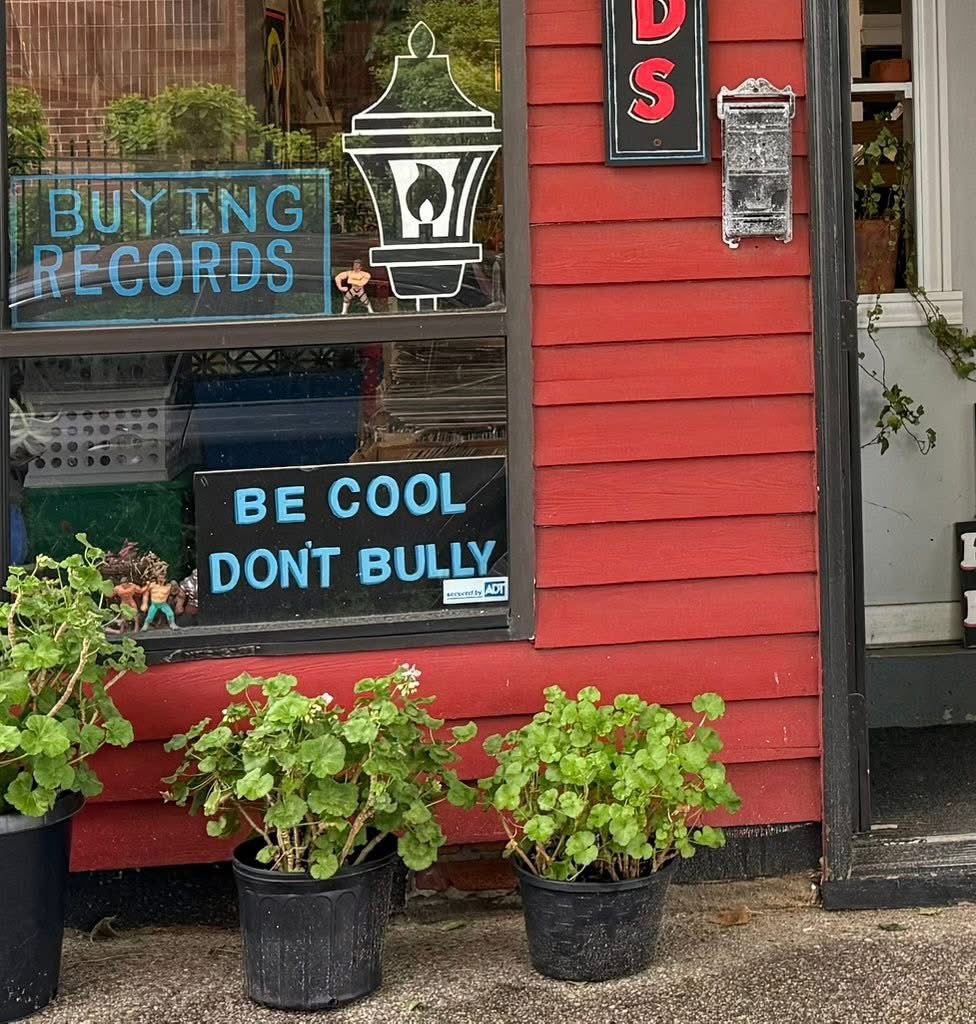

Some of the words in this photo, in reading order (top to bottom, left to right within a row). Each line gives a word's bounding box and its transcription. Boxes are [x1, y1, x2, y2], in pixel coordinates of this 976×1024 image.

[48, 184, 304, 238] BUYING
[33, 239, 294, 299] RECORDS
[233, 485, 306, 525] BE
[328, 472, 467, 520] COOL
[209, 541, 340, 594] DON'T
[359, 540, 496, 586] BULLY
[485, 582, 504, 595] ADT
